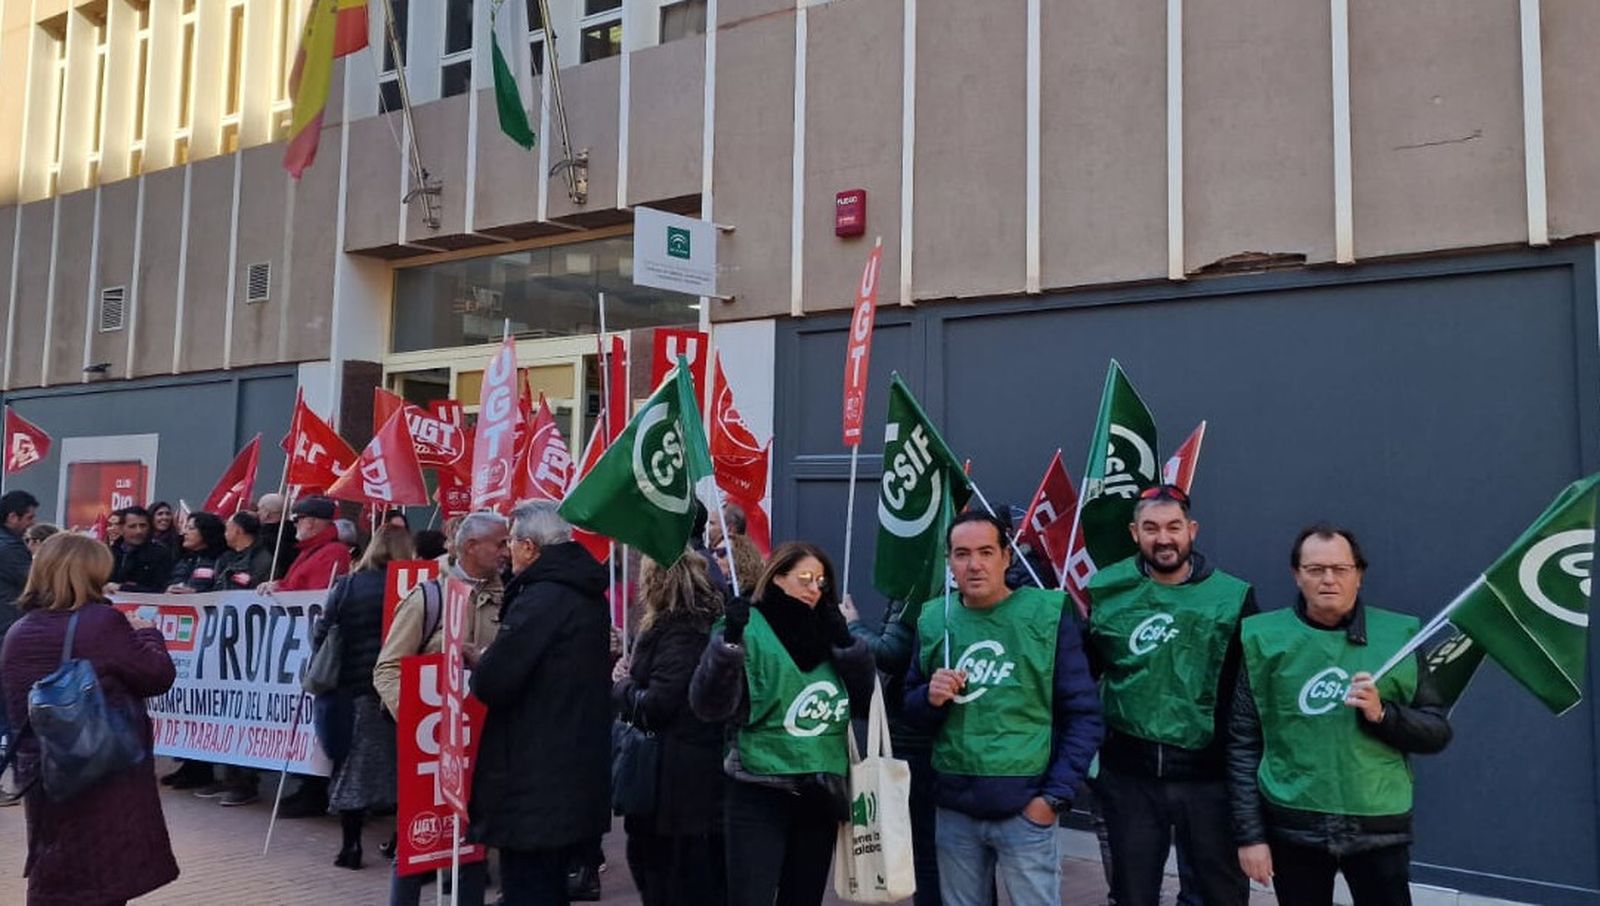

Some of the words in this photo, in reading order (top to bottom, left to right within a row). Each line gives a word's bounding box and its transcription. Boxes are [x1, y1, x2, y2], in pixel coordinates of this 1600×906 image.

[851, 256, 876, 388] UGT
[484, 347, 512, 460] UGT
[882, 423, 933, 511] CSIF
[164, 720, 180, 747] DE
[180, 721, 235, 754] TRABAJO
[244, 691, 263, 721] DEL
